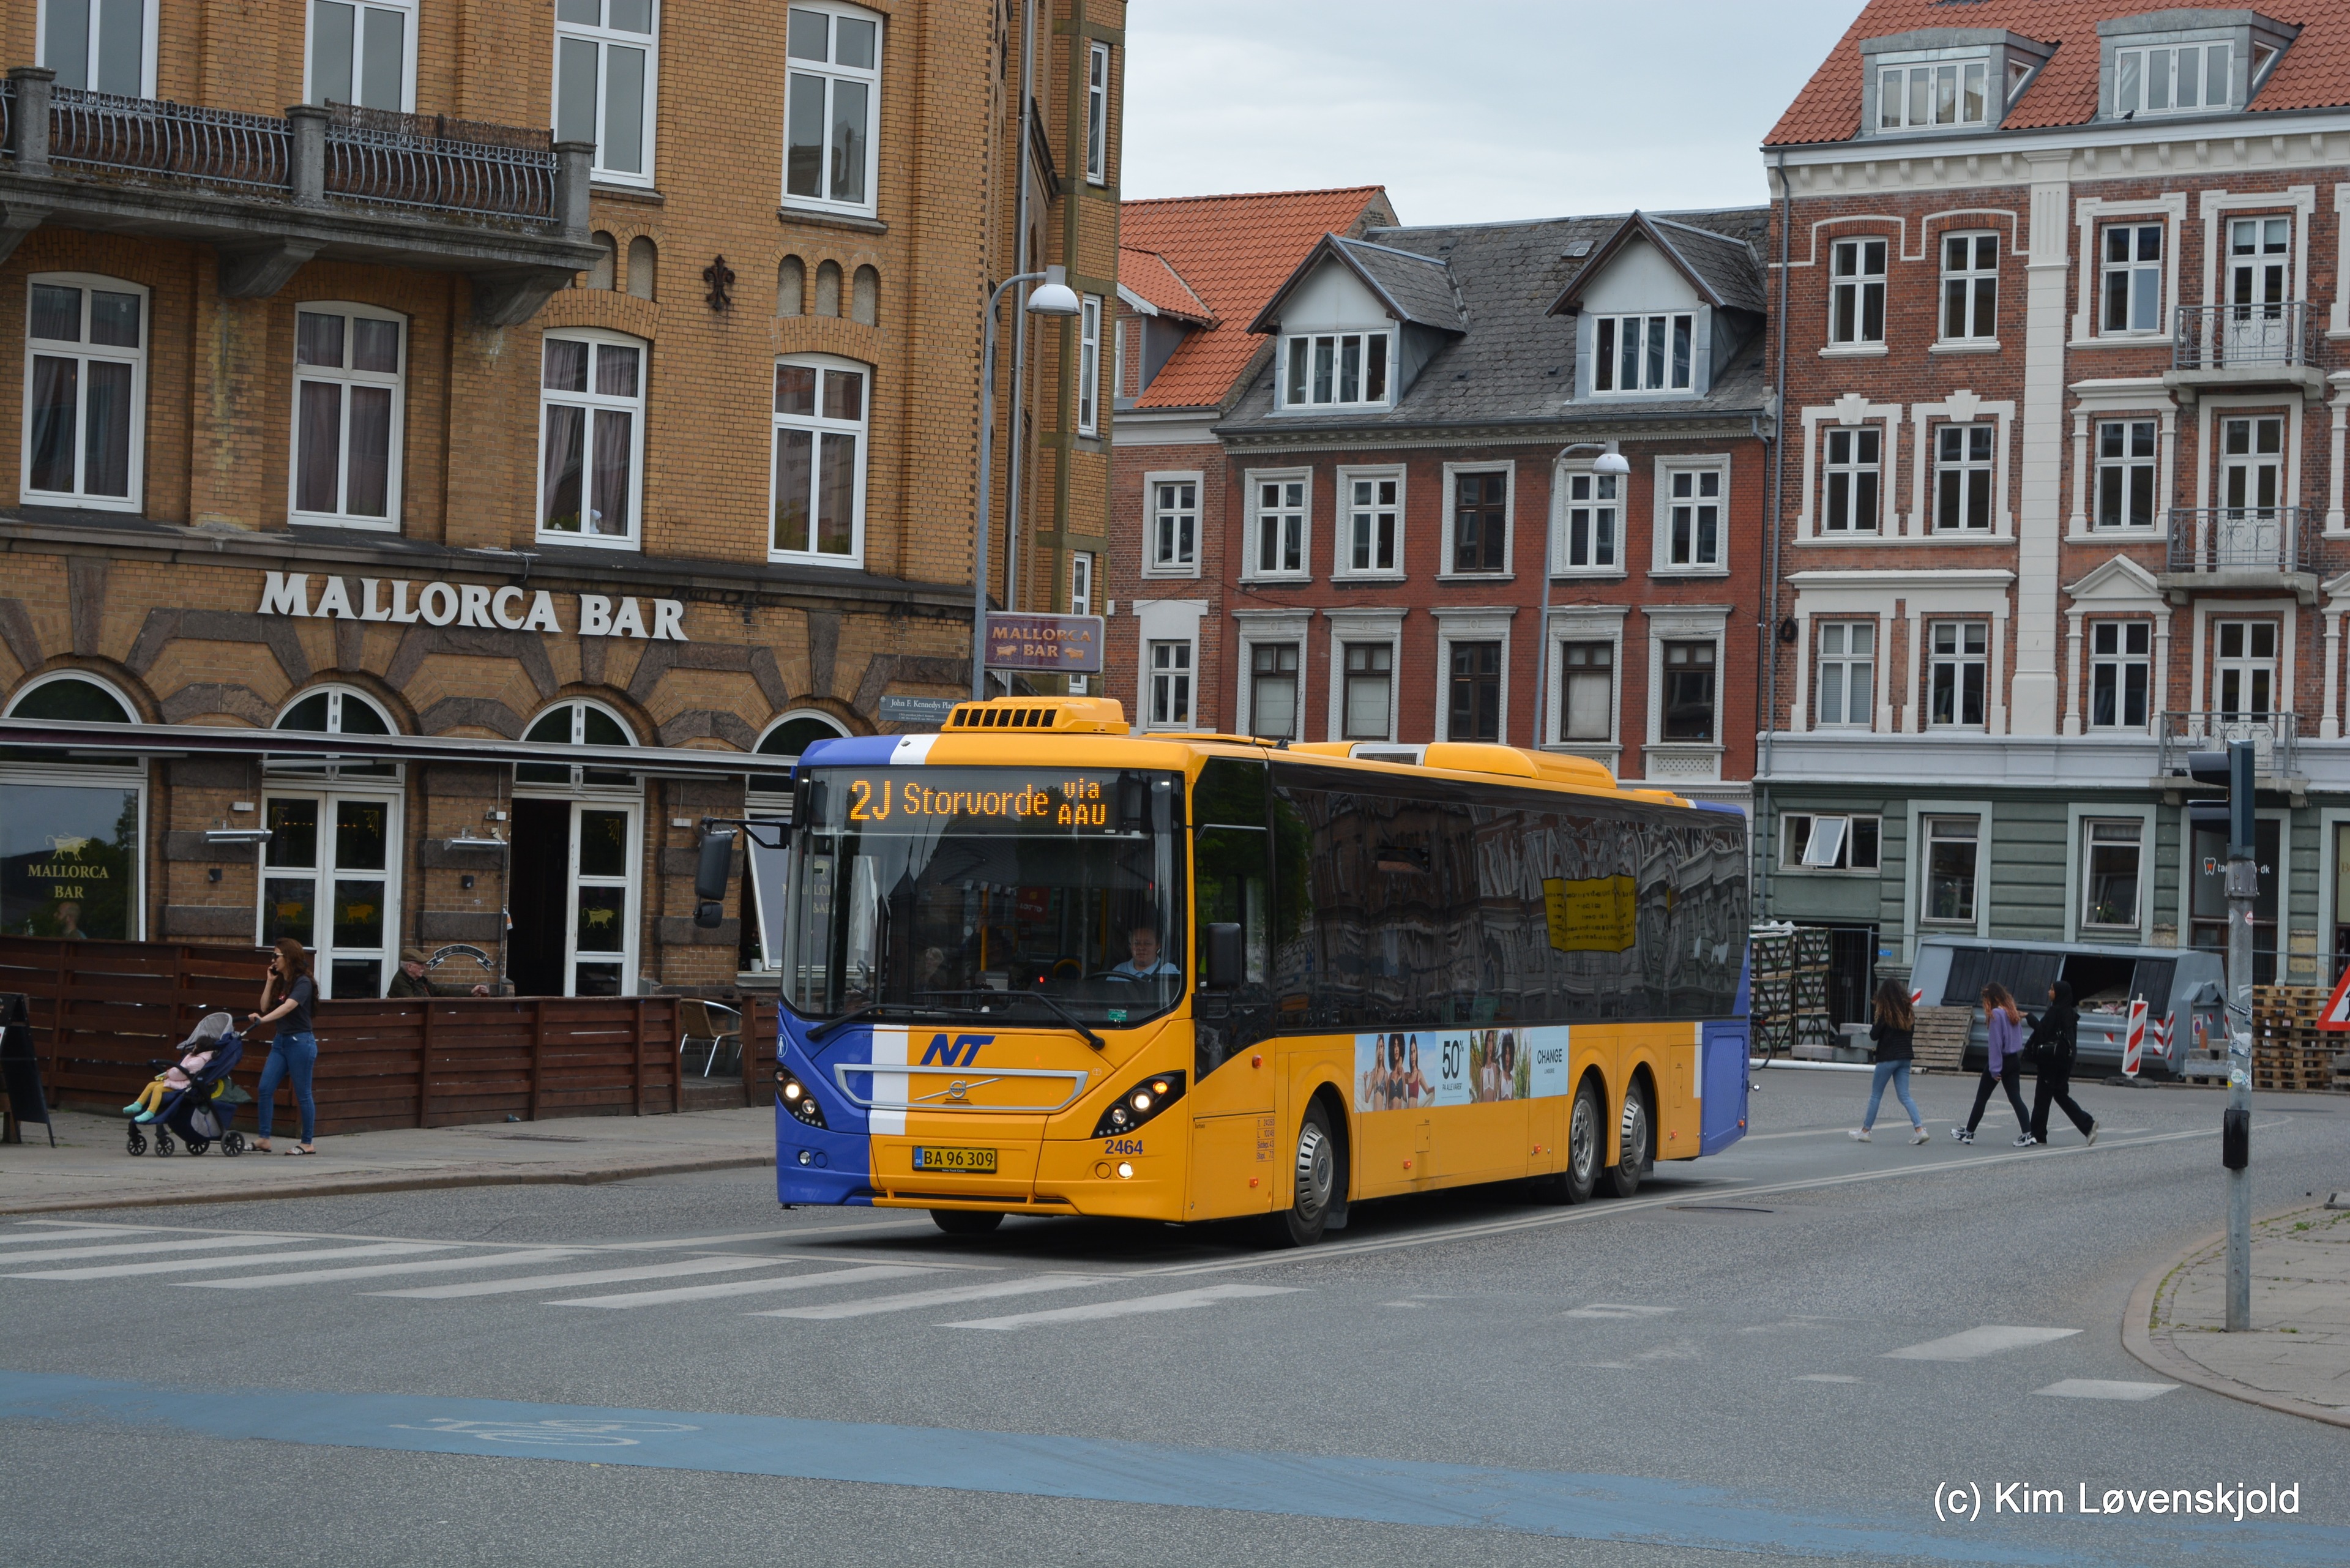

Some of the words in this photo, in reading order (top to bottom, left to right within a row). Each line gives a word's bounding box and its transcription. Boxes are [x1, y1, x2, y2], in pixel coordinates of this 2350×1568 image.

[257, 571, 563, 633] MALLORCA
[578, 594, 689, 641] BAR
[991, 627, 1091, 643] MALLORCA
[1023, 644, 1059, 657] BAR
[890, 699, 905, 708] John
[914, 700, 941, 710] Kennedys
[1064, 778, 1100, 799] via
[850, 780, 890, 819] 2J
[903, 783, 1049, 815] Storvorde
[1058, 804, 1106, 825] AAU
[28, 864, 109, 879] MALLORCA
[54, 885, 84, 899] BAR
[919, 1034, 996, 1067] NT
[1537, 1048, 1562, 1064] CHANGE
[1105, 1140, 1143, 1155] 2464
[924, 1151, 943, 1165] BA
[947, 1151, 964, 1165] 96
[967, 1152, 994, 1167] 309
